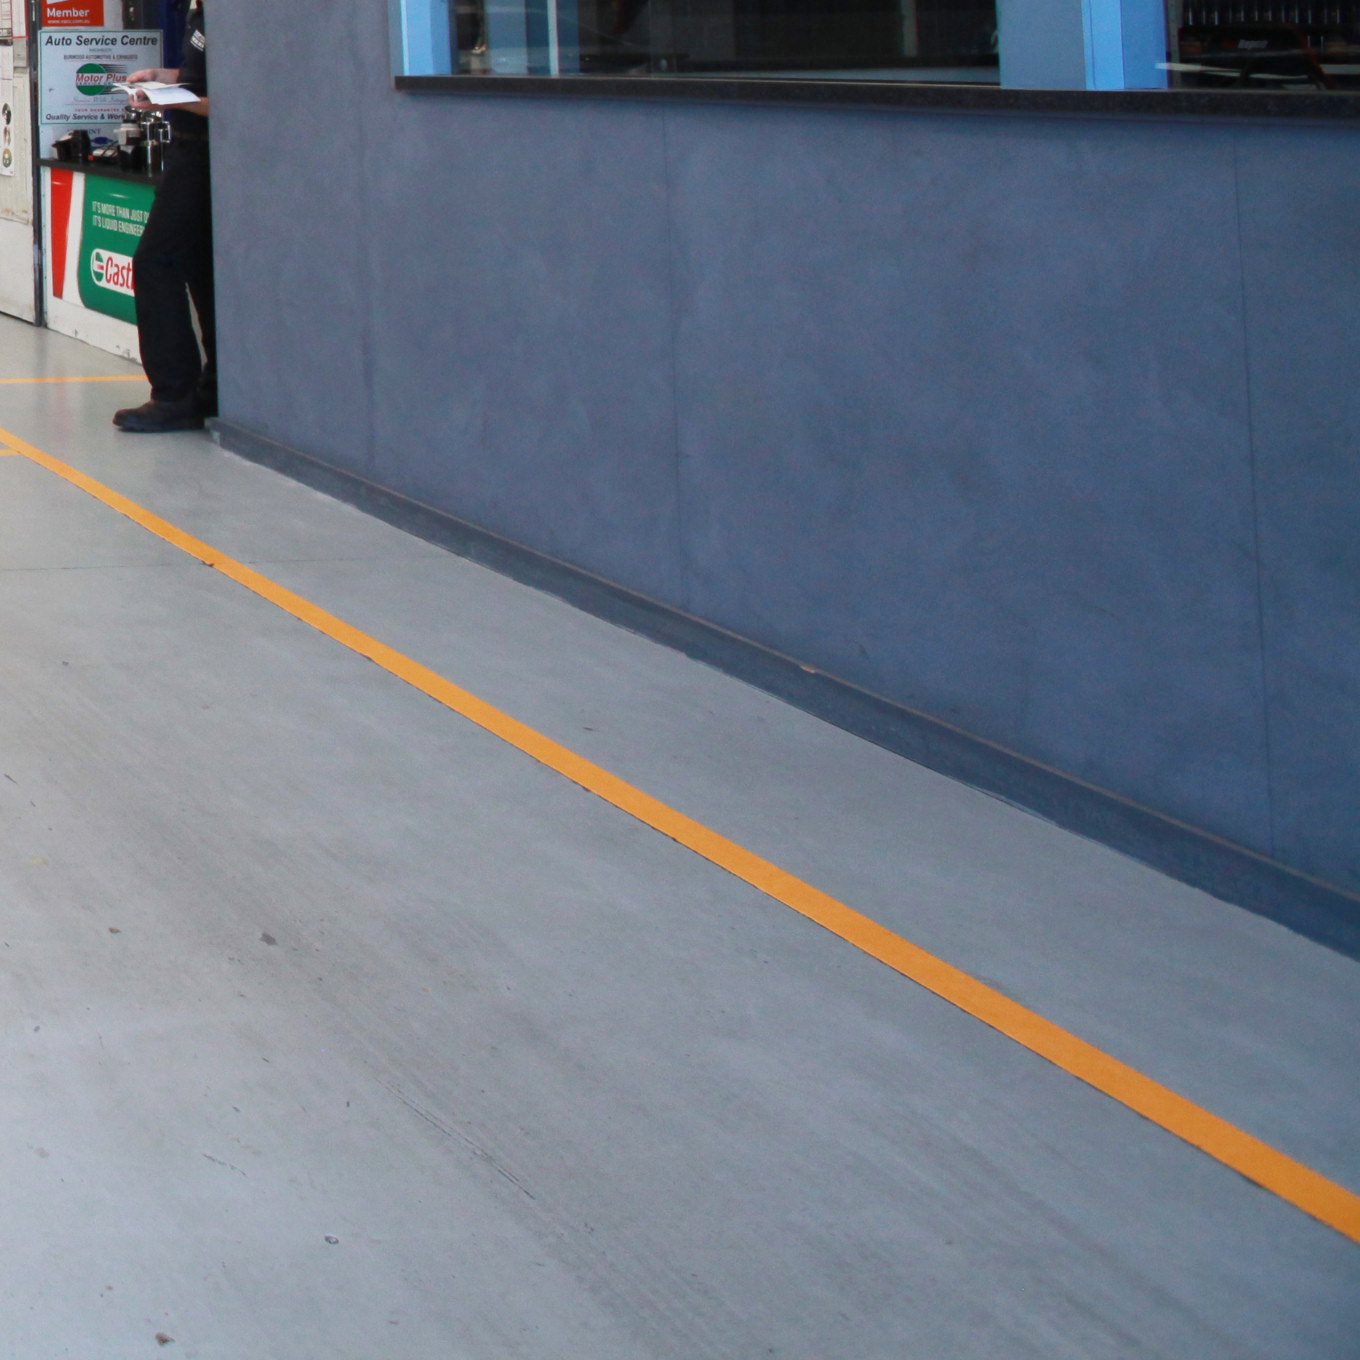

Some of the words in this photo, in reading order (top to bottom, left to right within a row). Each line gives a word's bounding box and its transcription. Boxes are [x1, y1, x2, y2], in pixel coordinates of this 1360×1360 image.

[46, 7, 90, 18] Member
[45, 35, 72, 46] Auto
[76, 35, 118, 46] Service
[120, 35, 158, 46] Centre
[75, 73, 103, 83] Motor
[106, 73, 128, 83] Plus
[45, 113, 70, 121] Quality
[72, 113, 99, 121] Service
[100, 113, 106, 121] &
[101, 203, 116, 217] MORE
[116, 205, 130, 220] THAN
[130, 208, 143, 222] JUST
[102, 216, 118, 232] LIQUID
[105, 256, 134, 290] Cast
